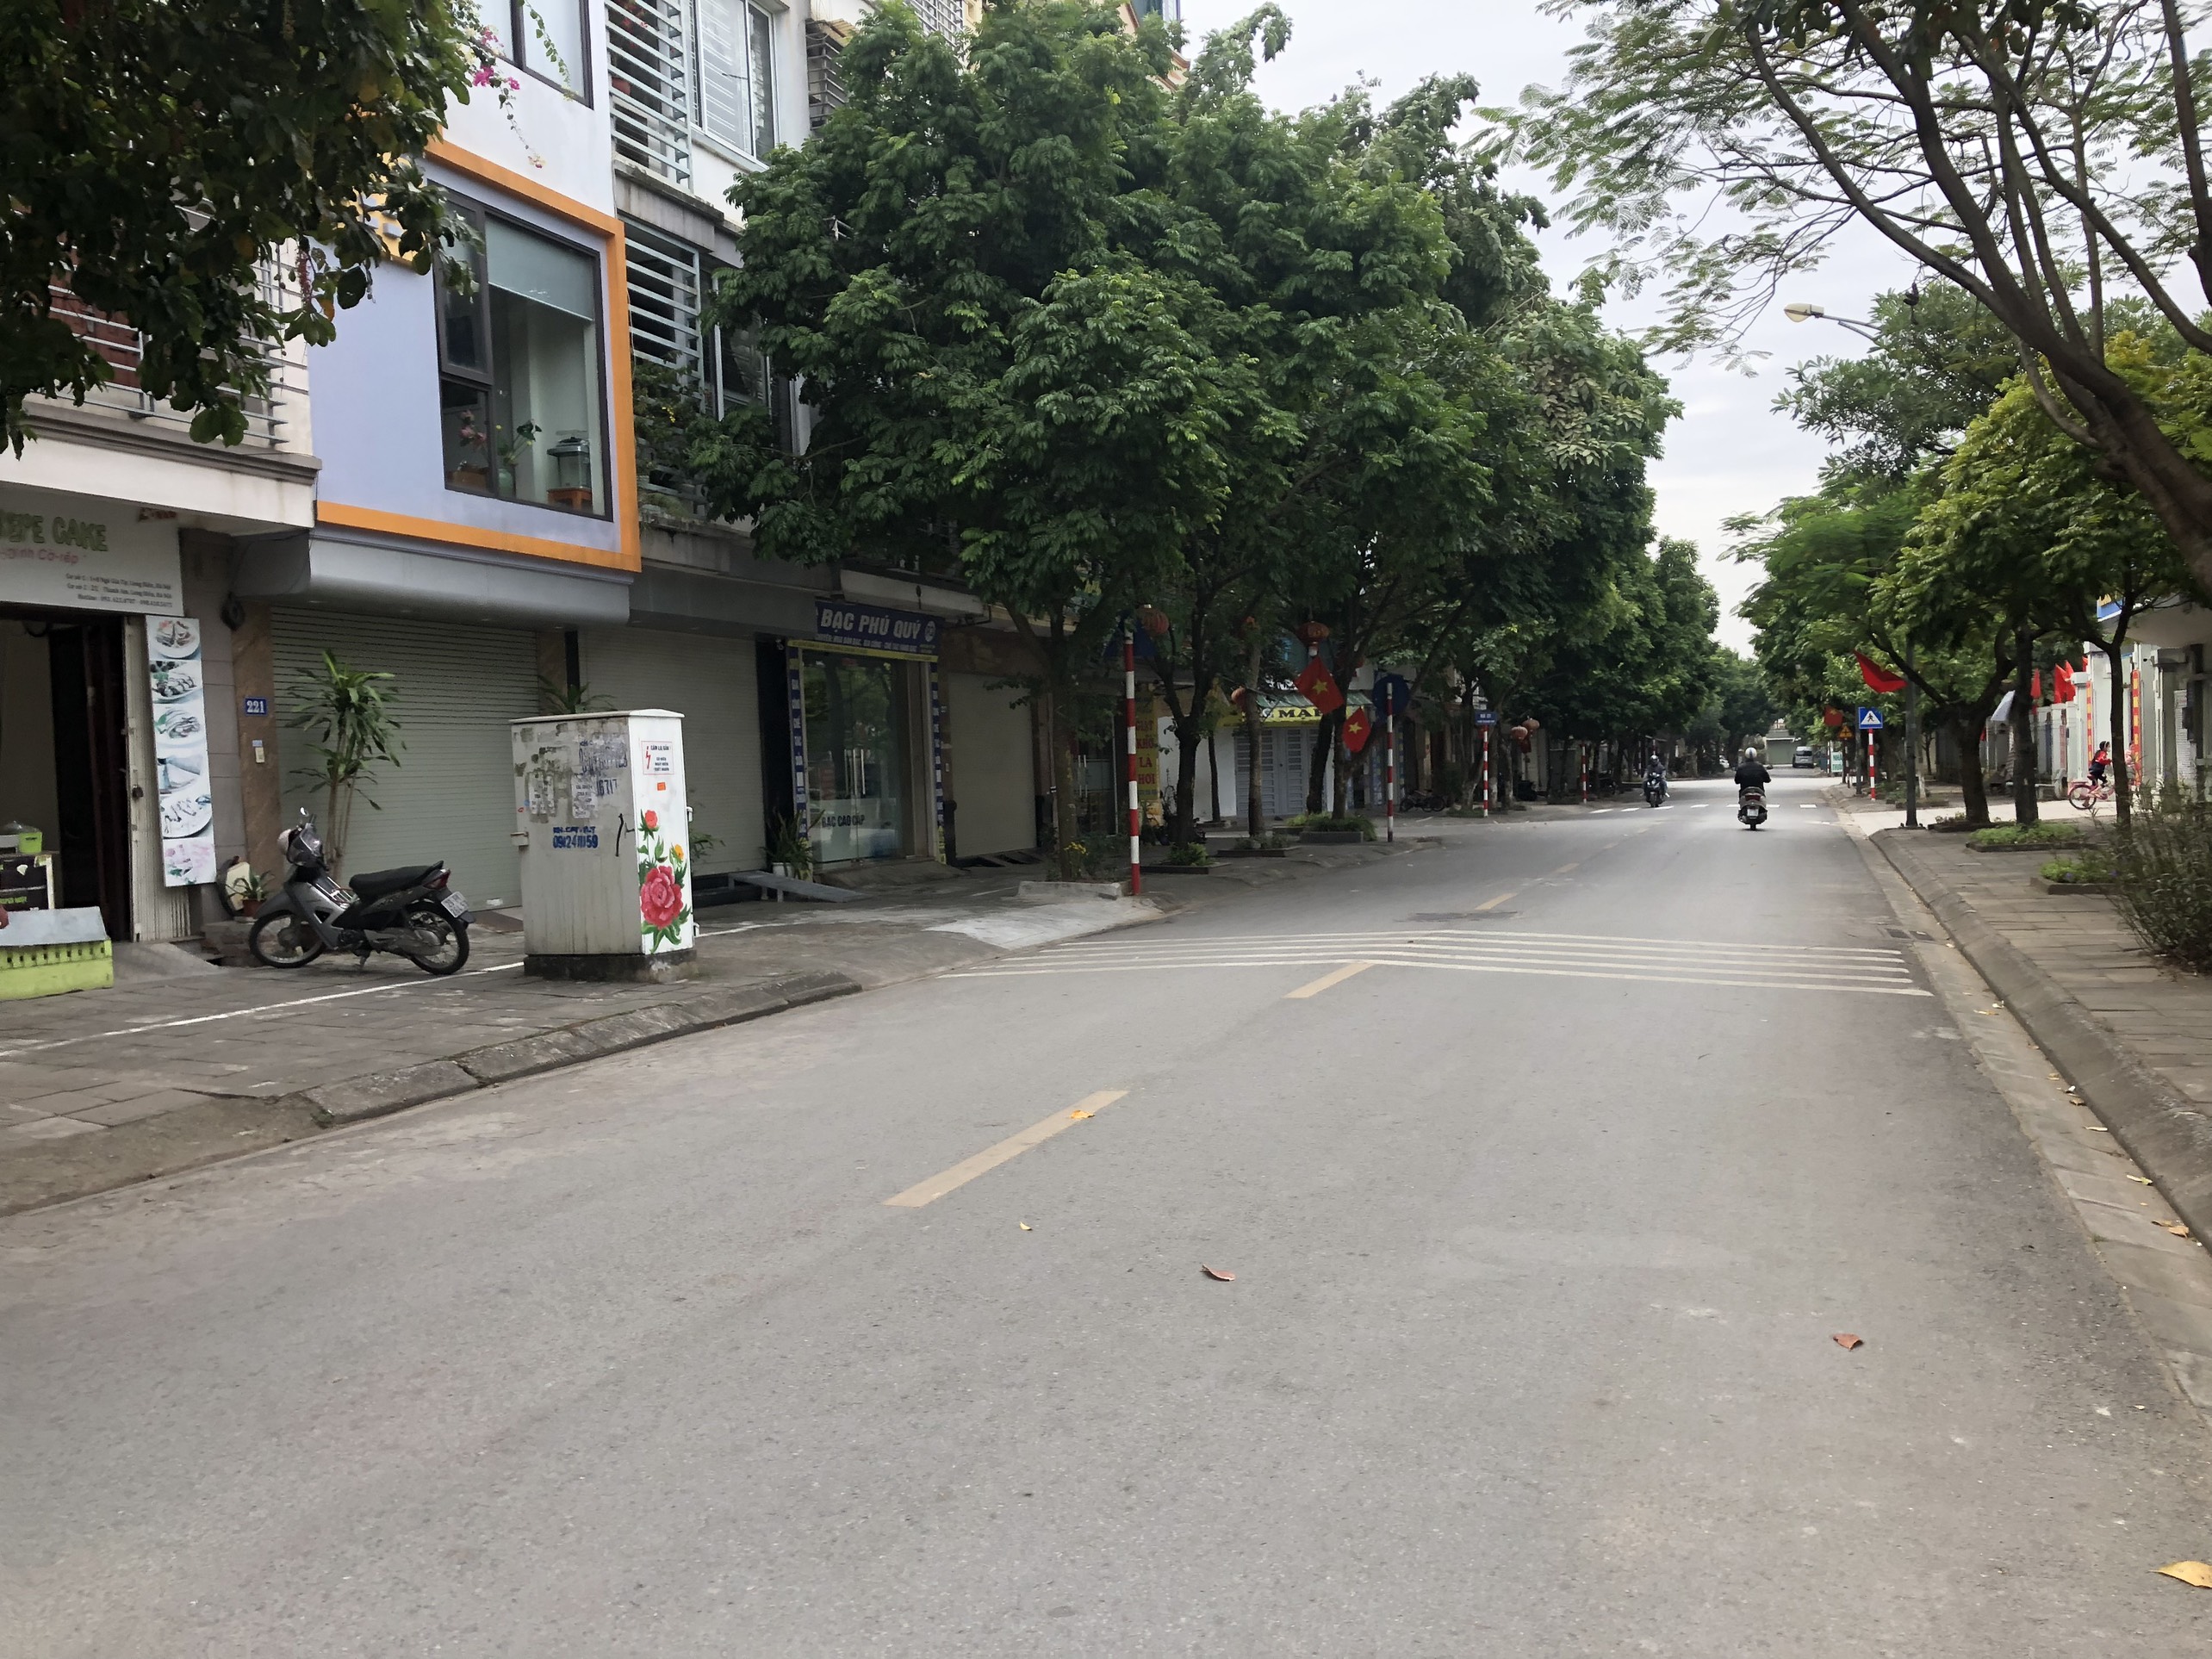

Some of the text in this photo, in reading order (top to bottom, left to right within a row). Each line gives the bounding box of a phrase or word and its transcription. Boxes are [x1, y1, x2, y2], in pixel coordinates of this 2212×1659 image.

[53, 516, 109, 551] CAKE
[821, 608, 854, 633] BẠC
[858, 614, 891, 636] PHÚ
[892, 619, 922, 639] QUÝ
[246, 700, 265, 713] 221
